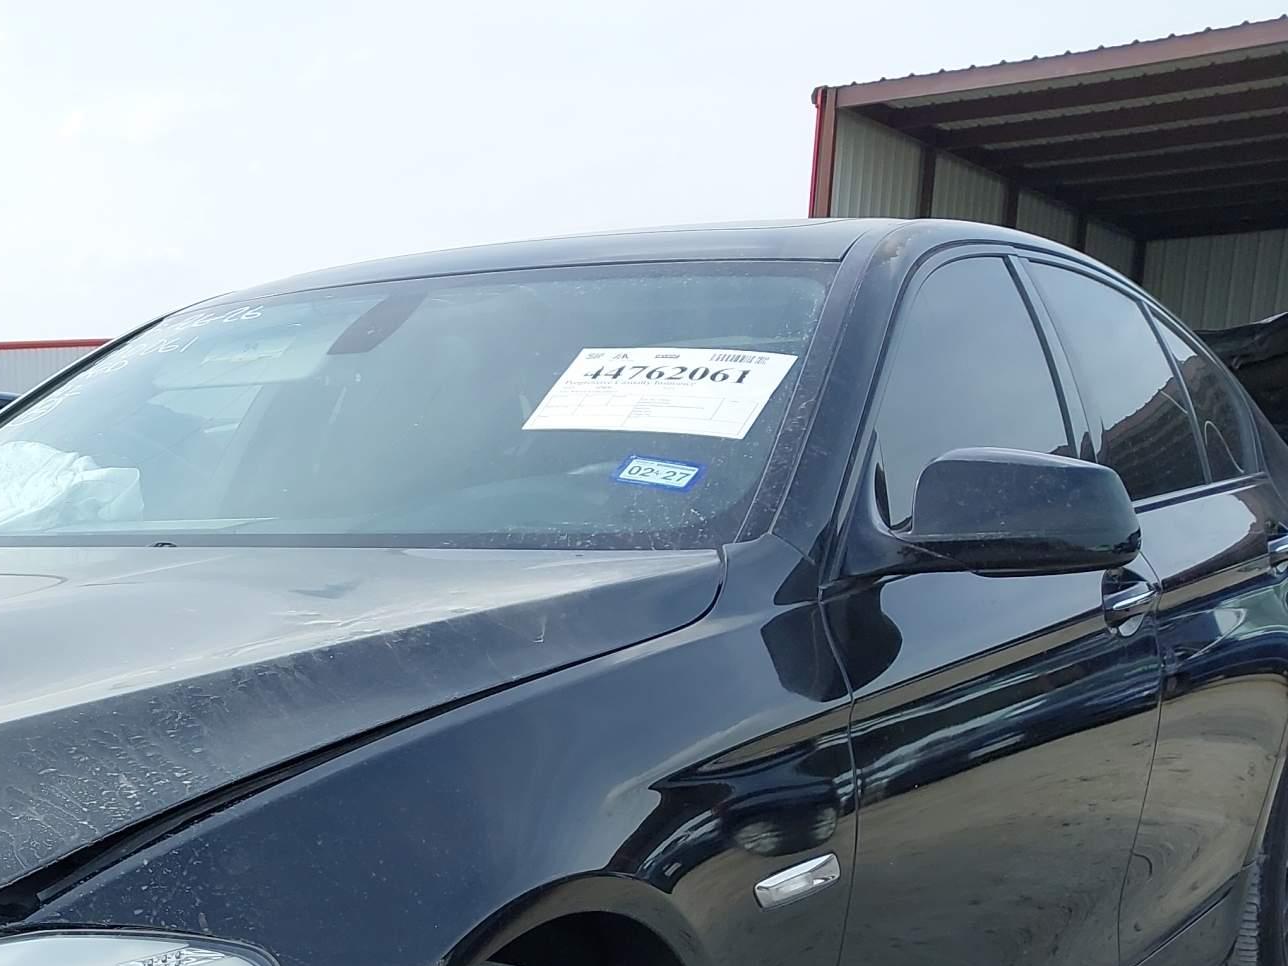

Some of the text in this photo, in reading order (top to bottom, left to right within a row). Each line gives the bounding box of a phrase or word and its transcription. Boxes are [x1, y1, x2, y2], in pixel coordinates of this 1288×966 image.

[583, 364, 752, 384] 44762061
[627, 465, 691, 482] 02 27
